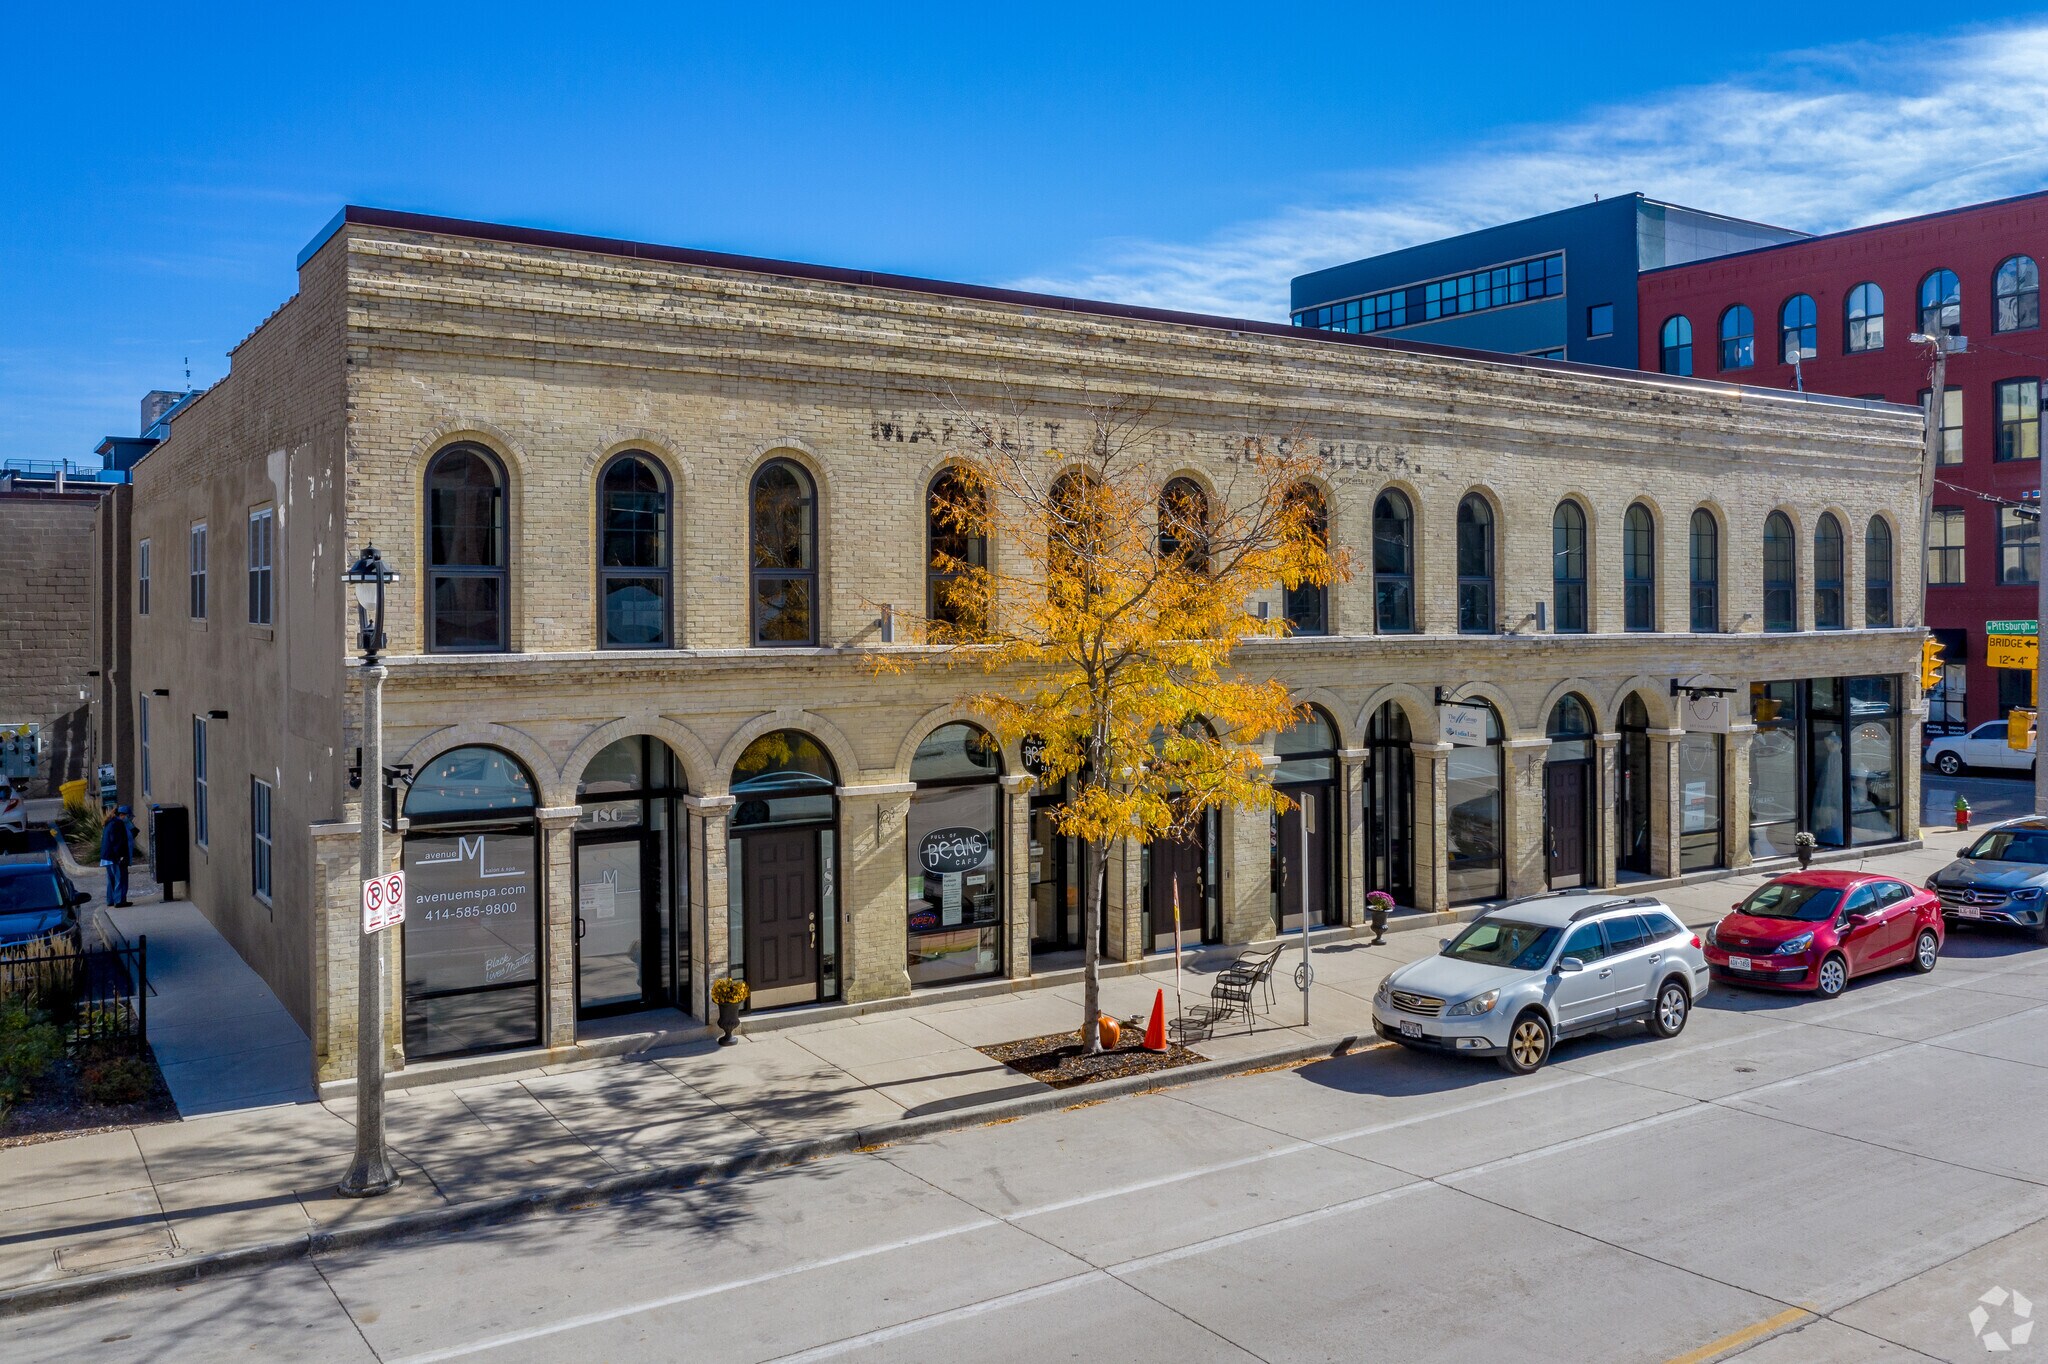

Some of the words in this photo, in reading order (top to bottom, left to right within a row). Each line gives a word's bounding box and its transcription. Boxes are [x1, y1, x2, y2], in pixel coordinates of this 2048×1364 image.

[1992, 622, 2030, 633] Pittsburgh
[1989, 638, 2023, 648] BRIDGE
[592, 807, 623, 823] 180
[424, 851, 457, 860] avenue
[955, 857, 979, 866] CAFE
[416, 885, 526, 904] avenuemspa.com
[425, 902, 517, 921] 414-585-9800
[910, 916, 937, 925] OPEN
[485, 953, 512, 971] Black
